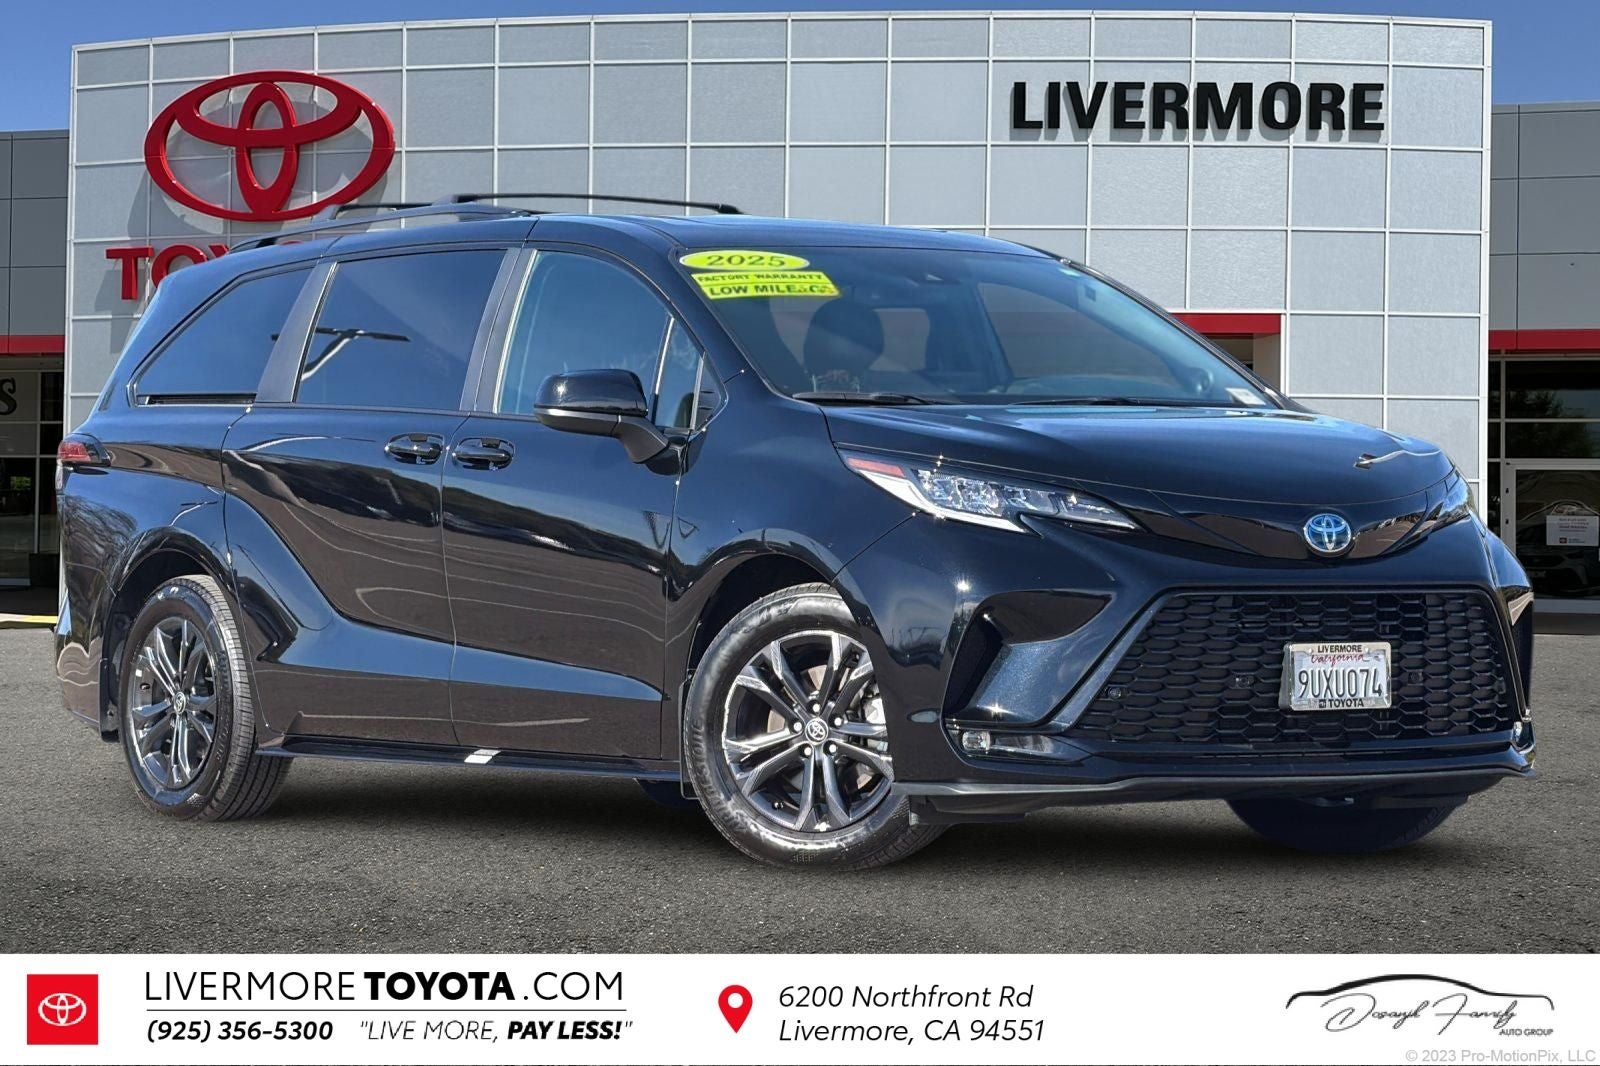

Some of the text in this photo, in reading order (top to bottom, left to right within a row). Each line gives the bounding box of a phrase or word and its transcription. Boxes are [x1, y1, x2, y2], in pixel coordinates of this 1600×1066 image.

[1012, 81, 1385, 131] LIVERMORE
[706, 254, 786, 267] 2025
[698, 272, 822, 282] FACTORY WARRANTY
[709, 285, 748, 296] LOW
[1317, 644, 1363, 654] LIVERMORE
[1310, 653, 1371, 667] California
[1298, 667, 1383, 699] 9UXU074
[1328, 698, 1365, 708] TOYOTA
